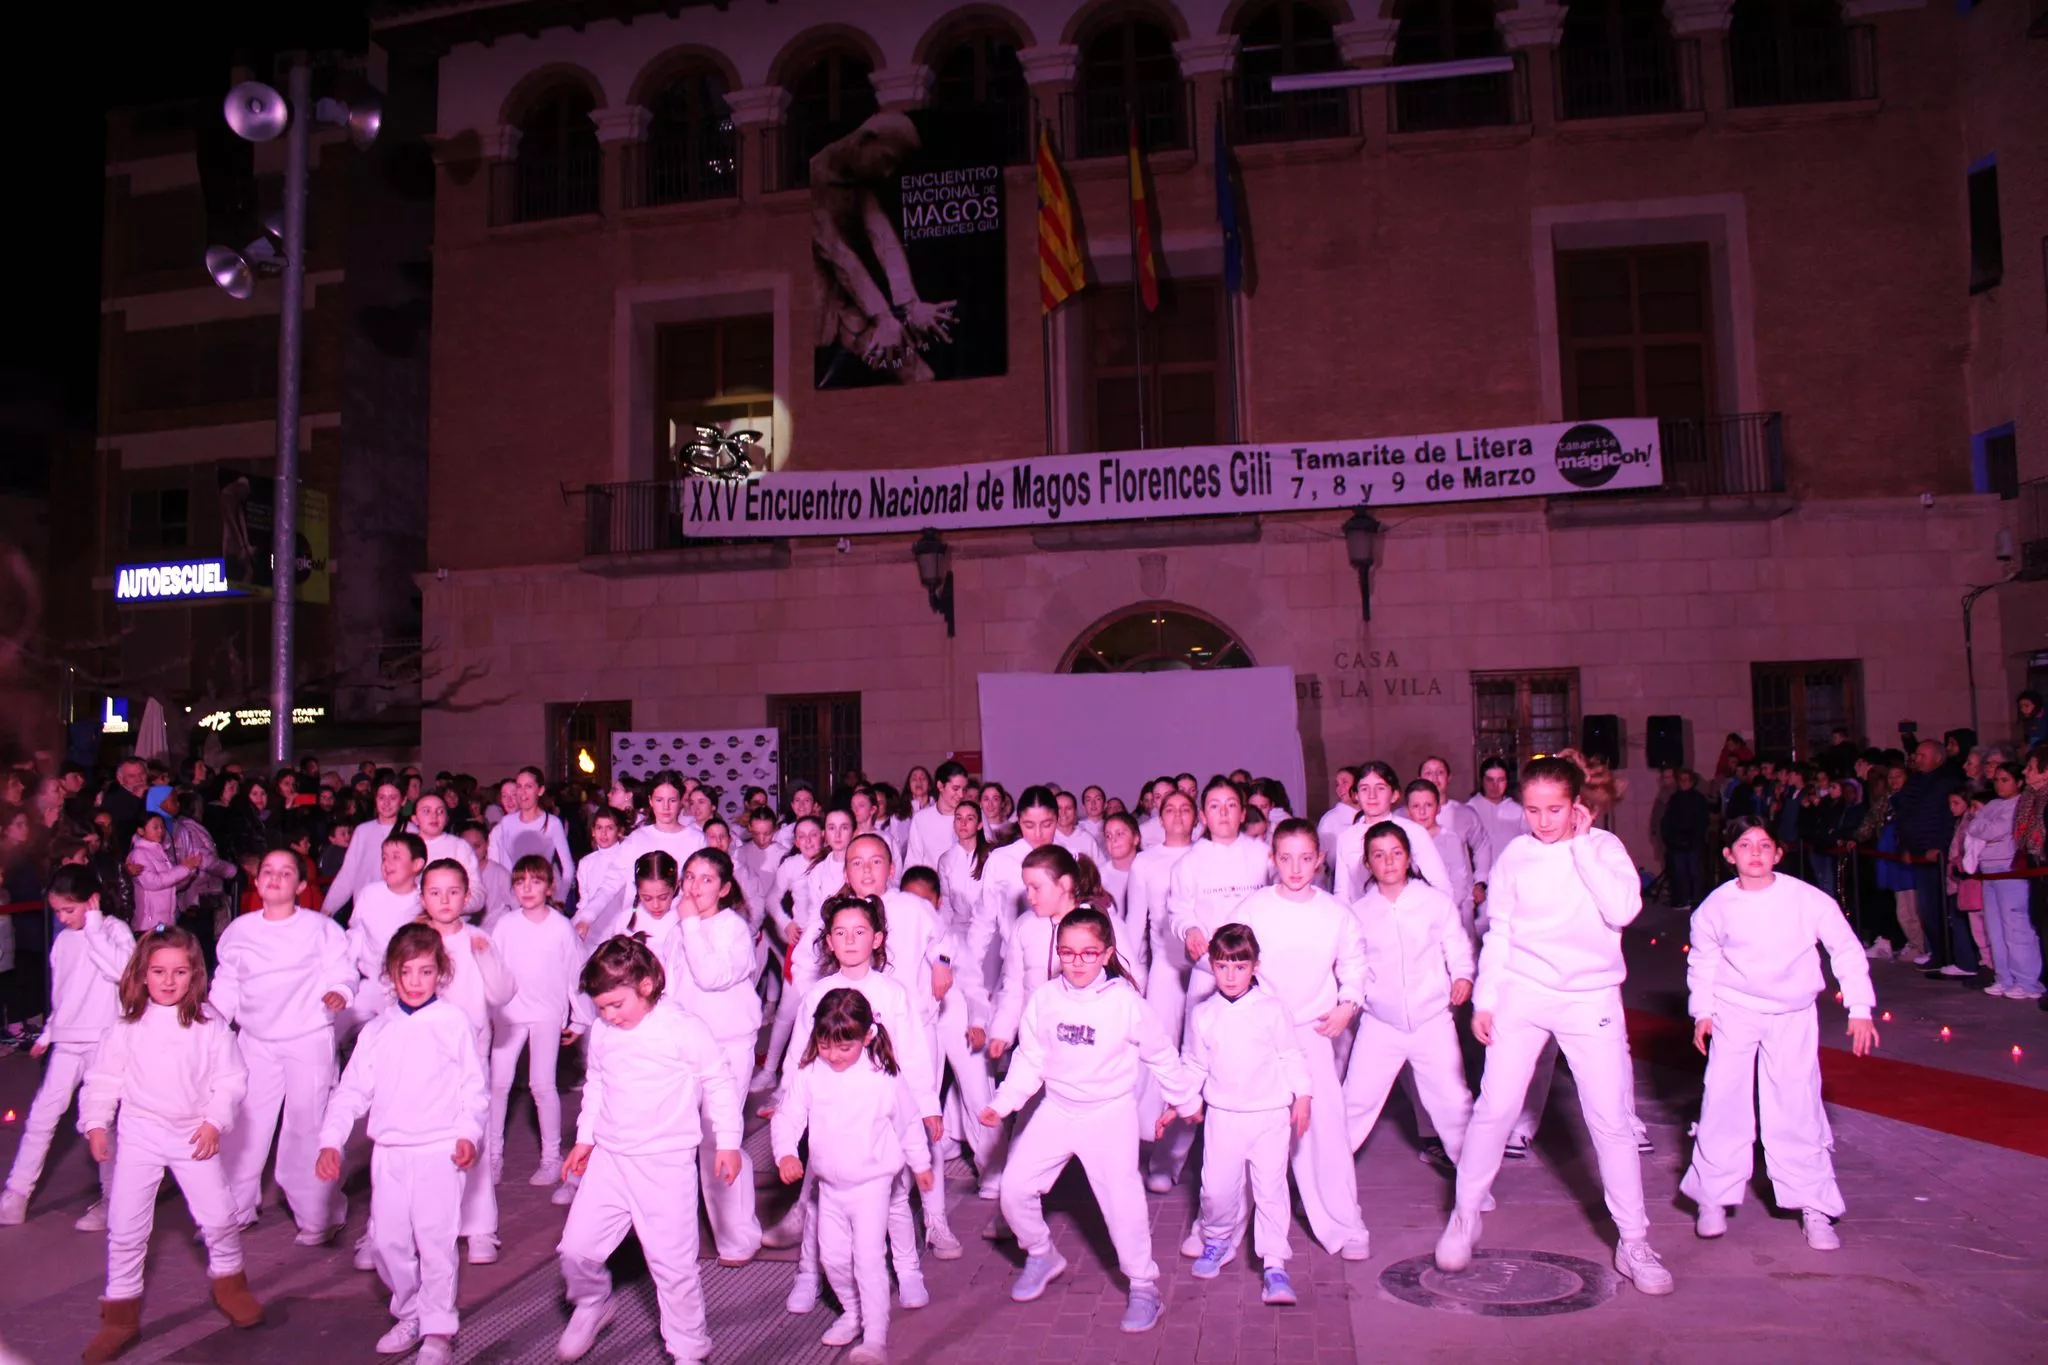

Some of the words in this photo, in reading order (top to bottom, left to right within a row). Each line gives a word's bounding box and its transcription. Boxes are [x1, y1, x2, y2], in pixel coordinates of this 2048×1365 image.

[901, 165, 998, 189] ENCUENTRO
[902, 184, 980, 204] NACIONAL
[983, 185, 996, 195] DE
[903, 196, 998, 228] MAGOS
[903, 222, 974, 240] FLORENCES
[978, 218, 999, 232] GILI
[1291, 443, 1405, 470] Tamarite
[1415, 441, 1446, 464] de
[1456, 436, 1533, 462] Litera
[1558, 438, 1617, 451] tamarite
[690, 479, 739, 522] XXV
[745, 479, 862, 521] Encuentro
[870, 470, 968, 518] Nacional
[976, 469, 1004, 512] de
[1012, 465, 1091, 519] Magos
[1100, 457, 1220, 503] Florences
[1230, 451, 1272, 498] Gili
[1333, 475, 1346, 496] 8
[1360, 481, 1373, 501] y
[1392, 471, 1404, 493] 9
[1426, 469, 1455, 491] de
[1464, 465, 1536, 489] Marzo
[117, 563, 228, 598] AUTOESCUEL
[1334, 651, 1399, 669] CASA
[1340, 680, 1369, 698] LA
[1384, 678, 1441, 696] VILA
[240, 718, 271, 726] LABOR
